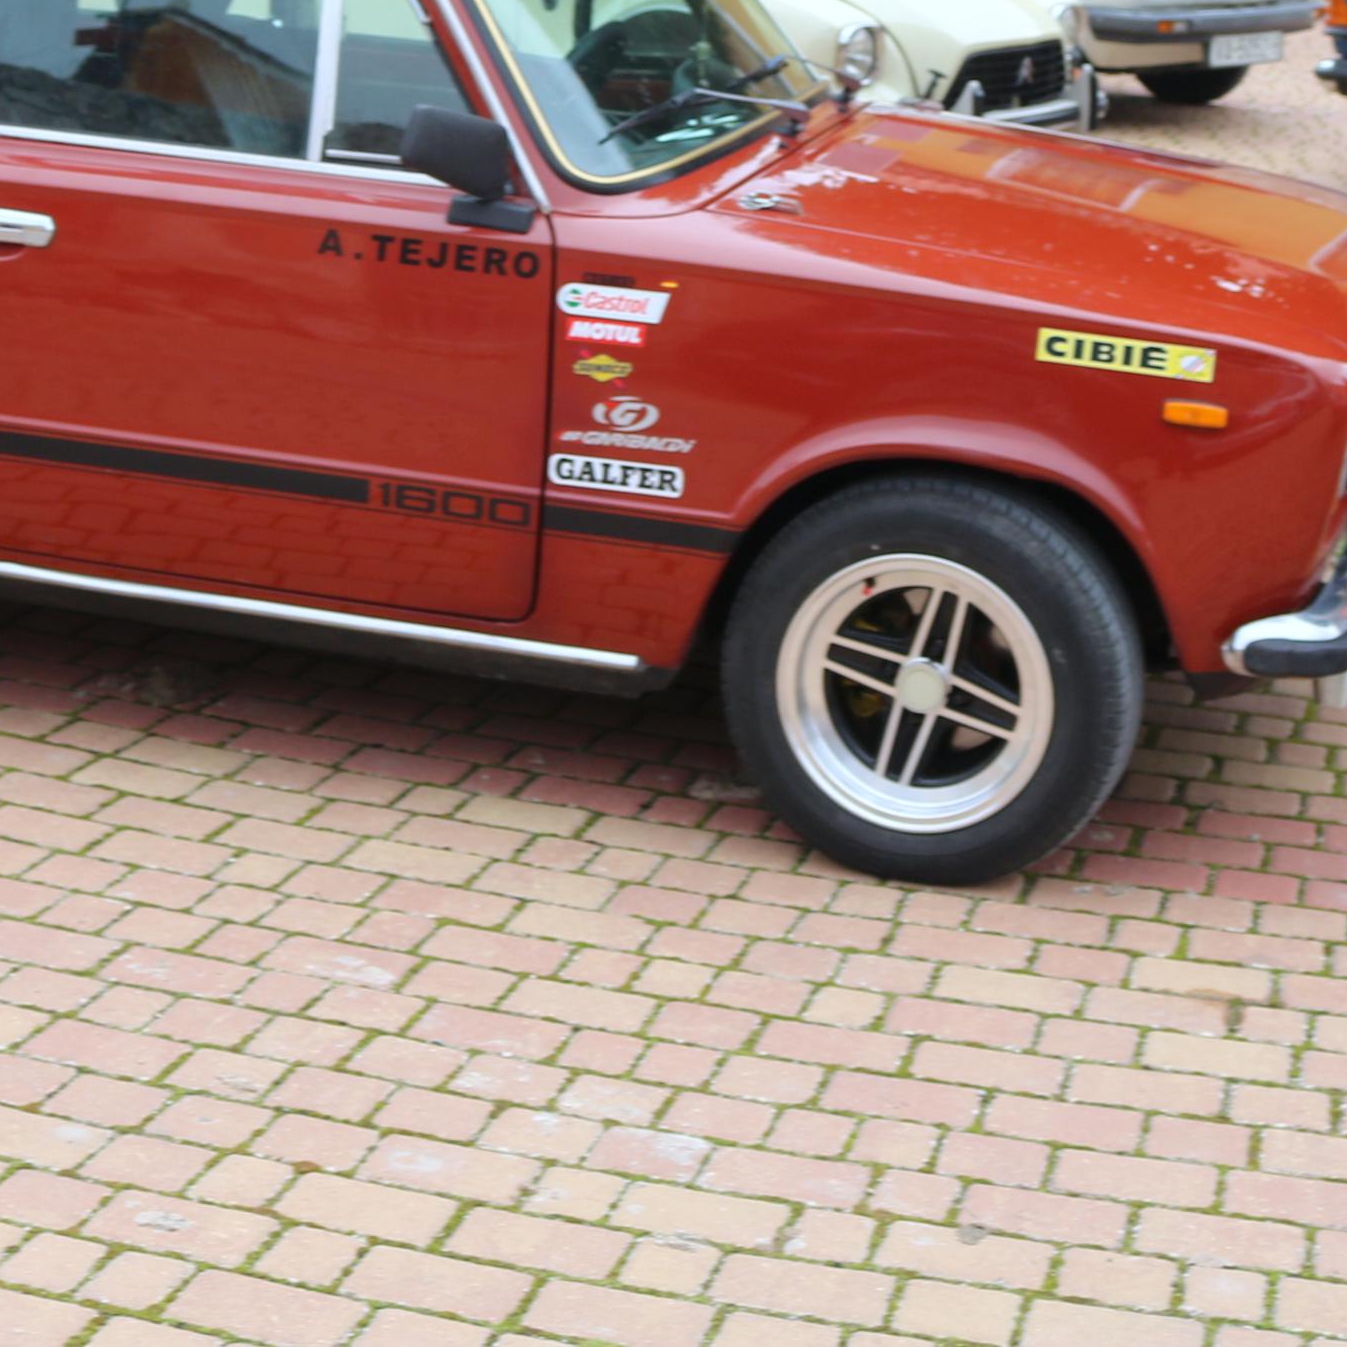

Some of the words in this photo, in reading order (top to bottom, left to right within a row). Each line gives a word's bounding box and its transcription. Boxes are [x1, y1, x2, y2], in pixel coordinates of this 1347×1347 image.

[583, 291, 650, 314] Castrol
[568, 321, 642, 344] MOTUL
[556, 458, 677, 492] GALFER
[379, 483, 530, 527] 1600
